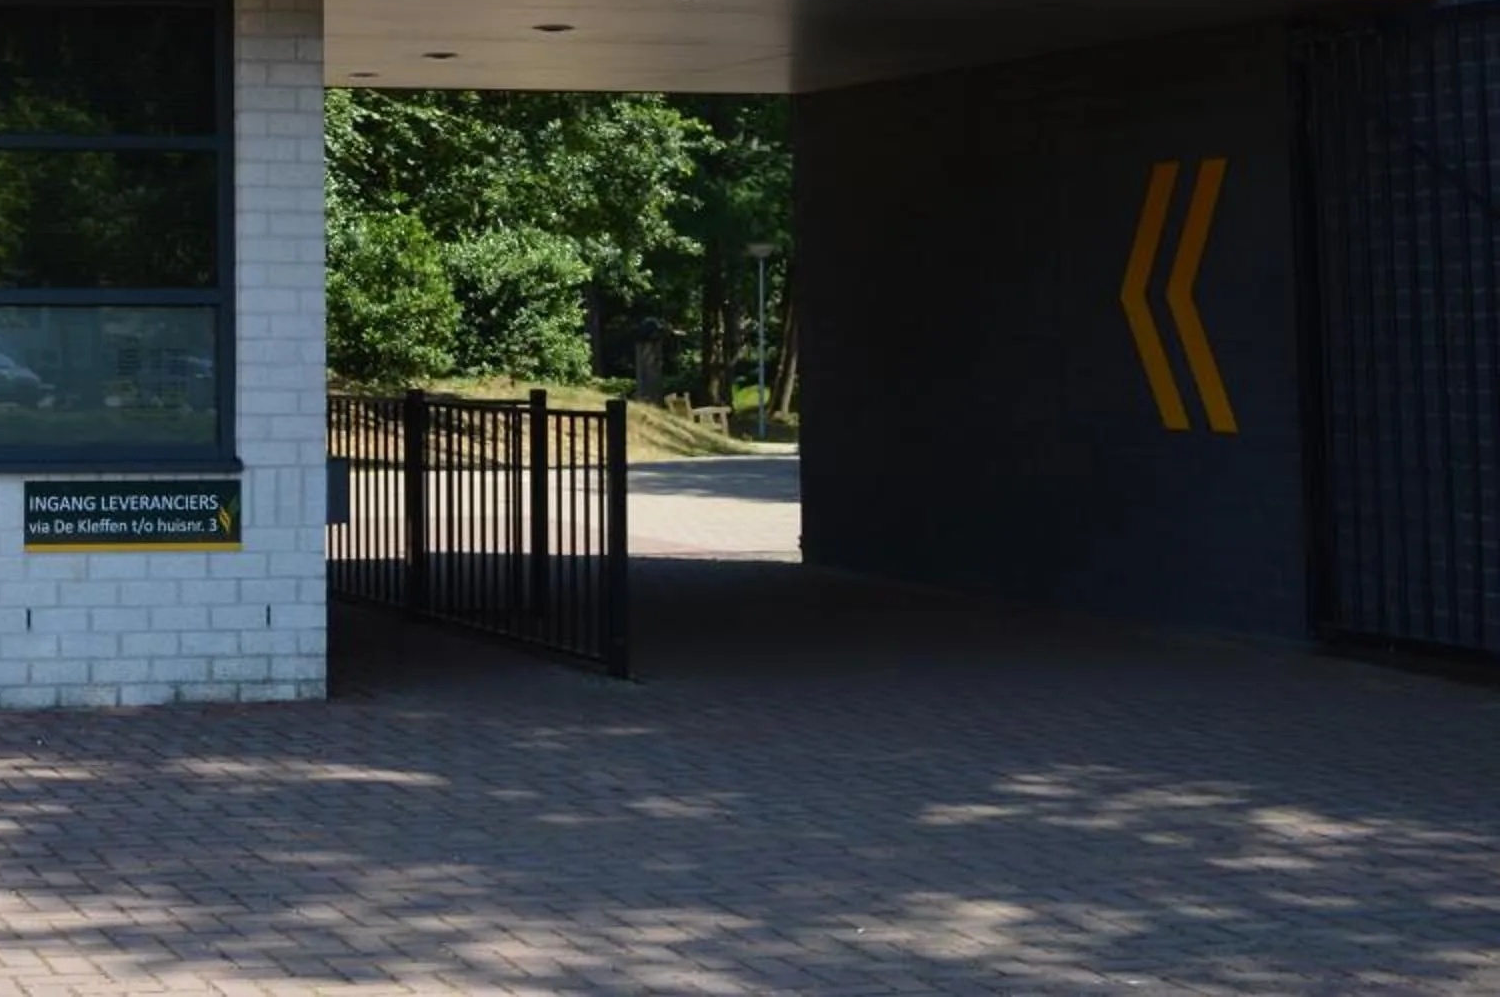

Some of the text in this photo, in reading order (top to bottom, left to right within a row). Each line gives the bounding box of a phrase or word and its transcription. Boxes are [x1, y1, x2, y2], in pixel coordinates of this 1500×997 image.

[29, 494, 219, 512] INGANG LEVERANCIERS
[29, 517, 218, 535] via De Kleffen t/o huisnr. 3
